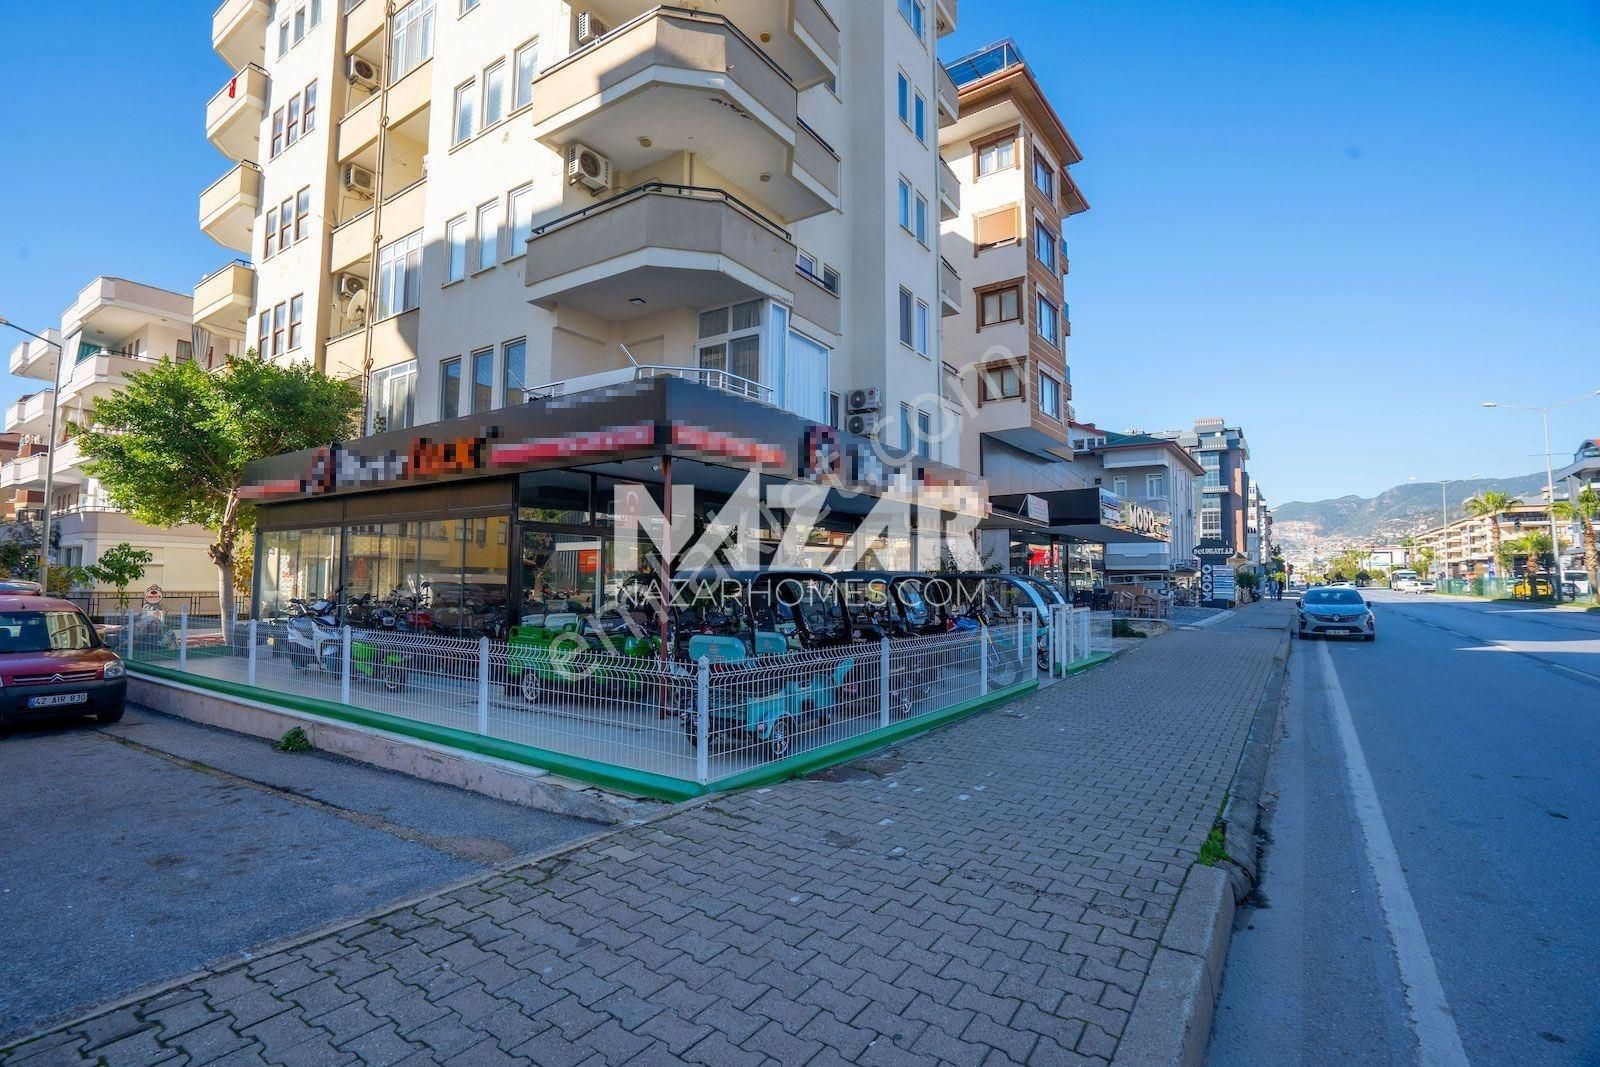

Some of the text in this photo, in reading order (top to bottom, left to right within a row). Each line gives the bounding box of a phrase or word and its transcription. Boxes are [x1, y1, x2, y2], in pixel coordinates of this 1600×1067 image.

[1201, 563, 1213, 602] MODO
[35, 697, 47, 705] 42
[51, 695, 66, 704] AIR
